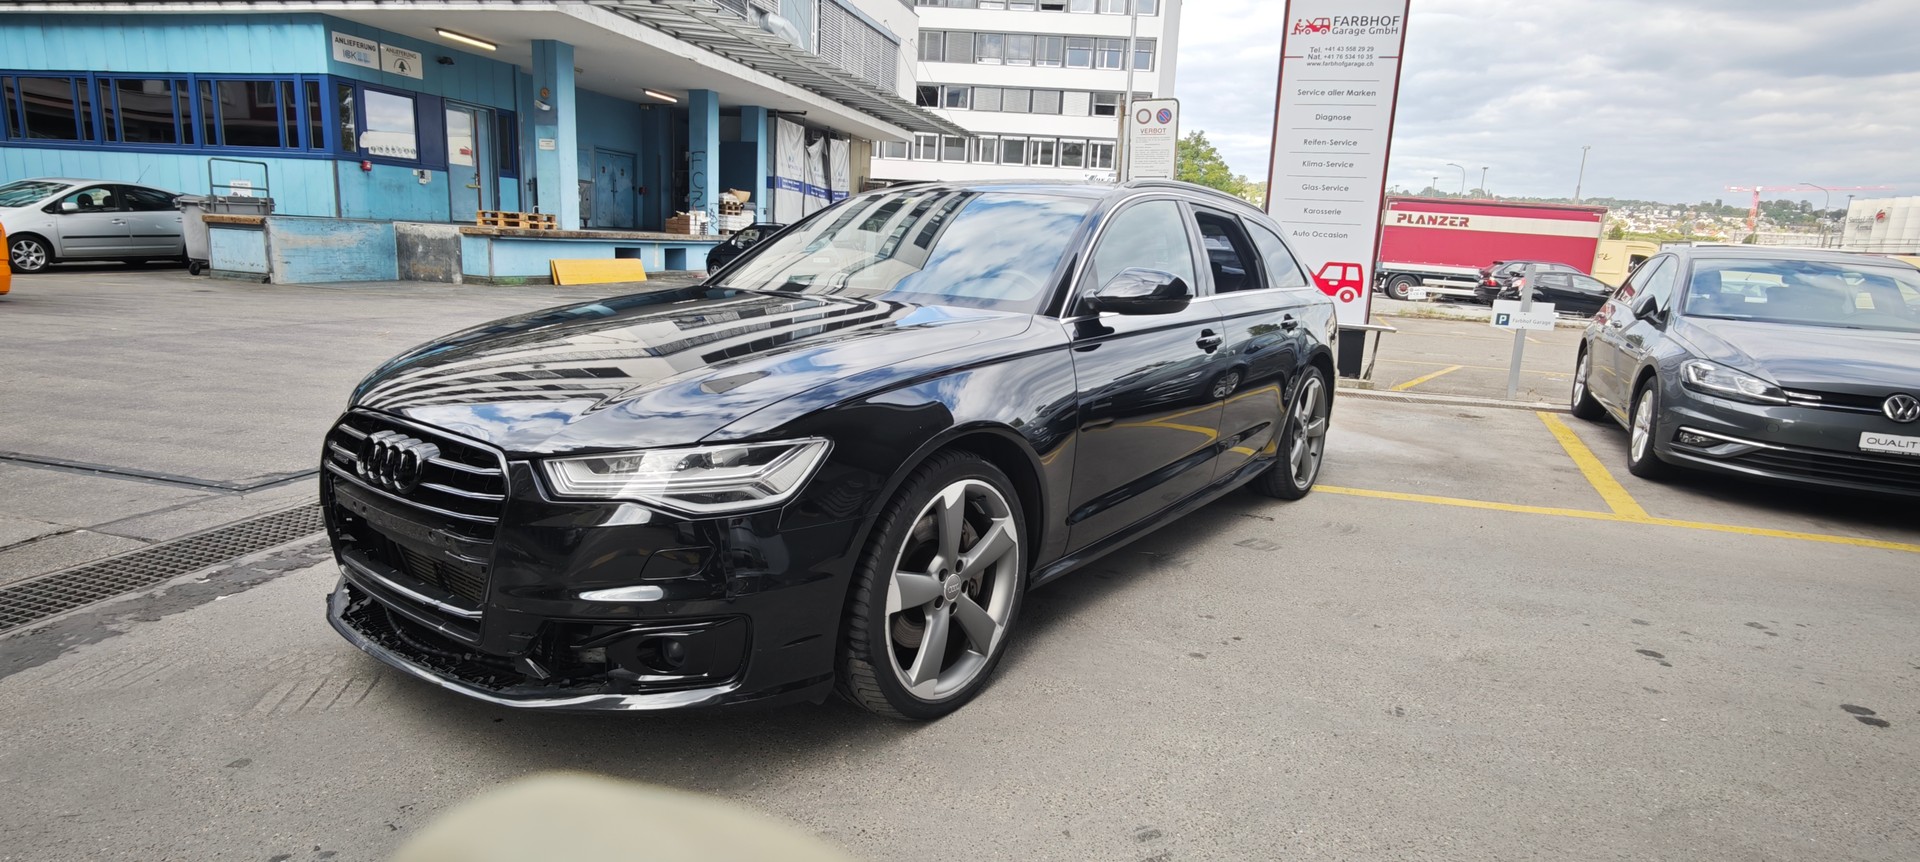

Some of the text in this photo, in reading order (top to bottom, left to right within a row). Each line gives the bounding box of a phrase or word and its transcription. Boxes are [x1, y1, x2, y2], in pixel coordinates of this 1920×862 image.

[1333, 16, 1400, 26] FARBHOF
[1332, 27, 1398, 36] Garage GmbH
[335, 36, 376, 52] ANLIEFERUNG
[386, 47, 417, 59] ANLIEFERUNG
[1346, 89, 1376, 97] Marken
[1315, 114, 1351, 122] Diagnose
[1397, 213, 1470, 228] PLANZER
[1292, 230, 1348, 239] Auto Occasion
[1499, 315, 1507, 324] P
[1866, 437, 1920, 449] QUALIT
